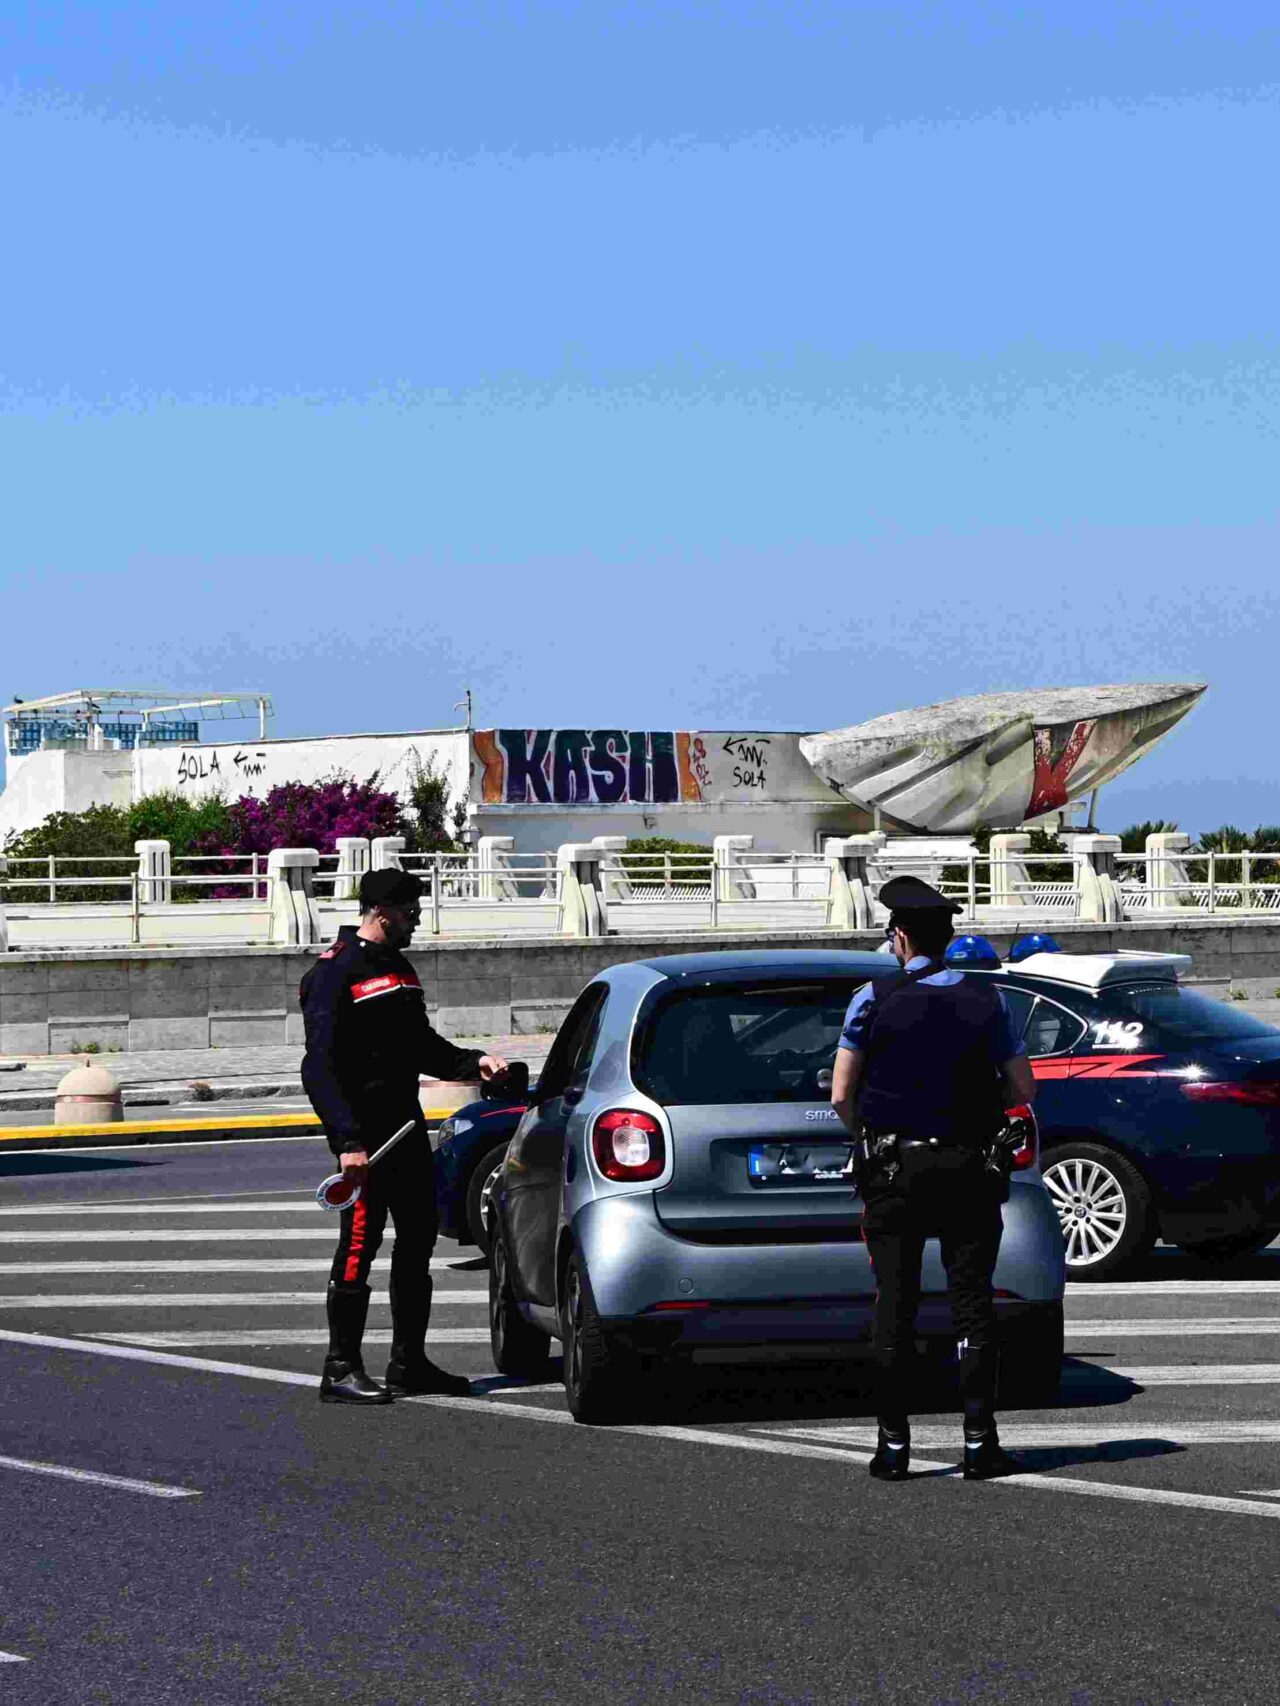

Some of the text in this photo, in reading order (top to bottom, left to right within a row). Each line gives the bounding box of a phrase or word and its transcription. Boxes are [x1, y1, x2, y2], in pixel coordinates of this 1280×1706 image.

[178, 750, 221, 784] SOLA
[500, 729, 679, 803] KASH
[733, 766, 766, 789] SOLA
[1091, 1020, 1144, 1045] 112
[805, 1109, 840, 1120] sma
